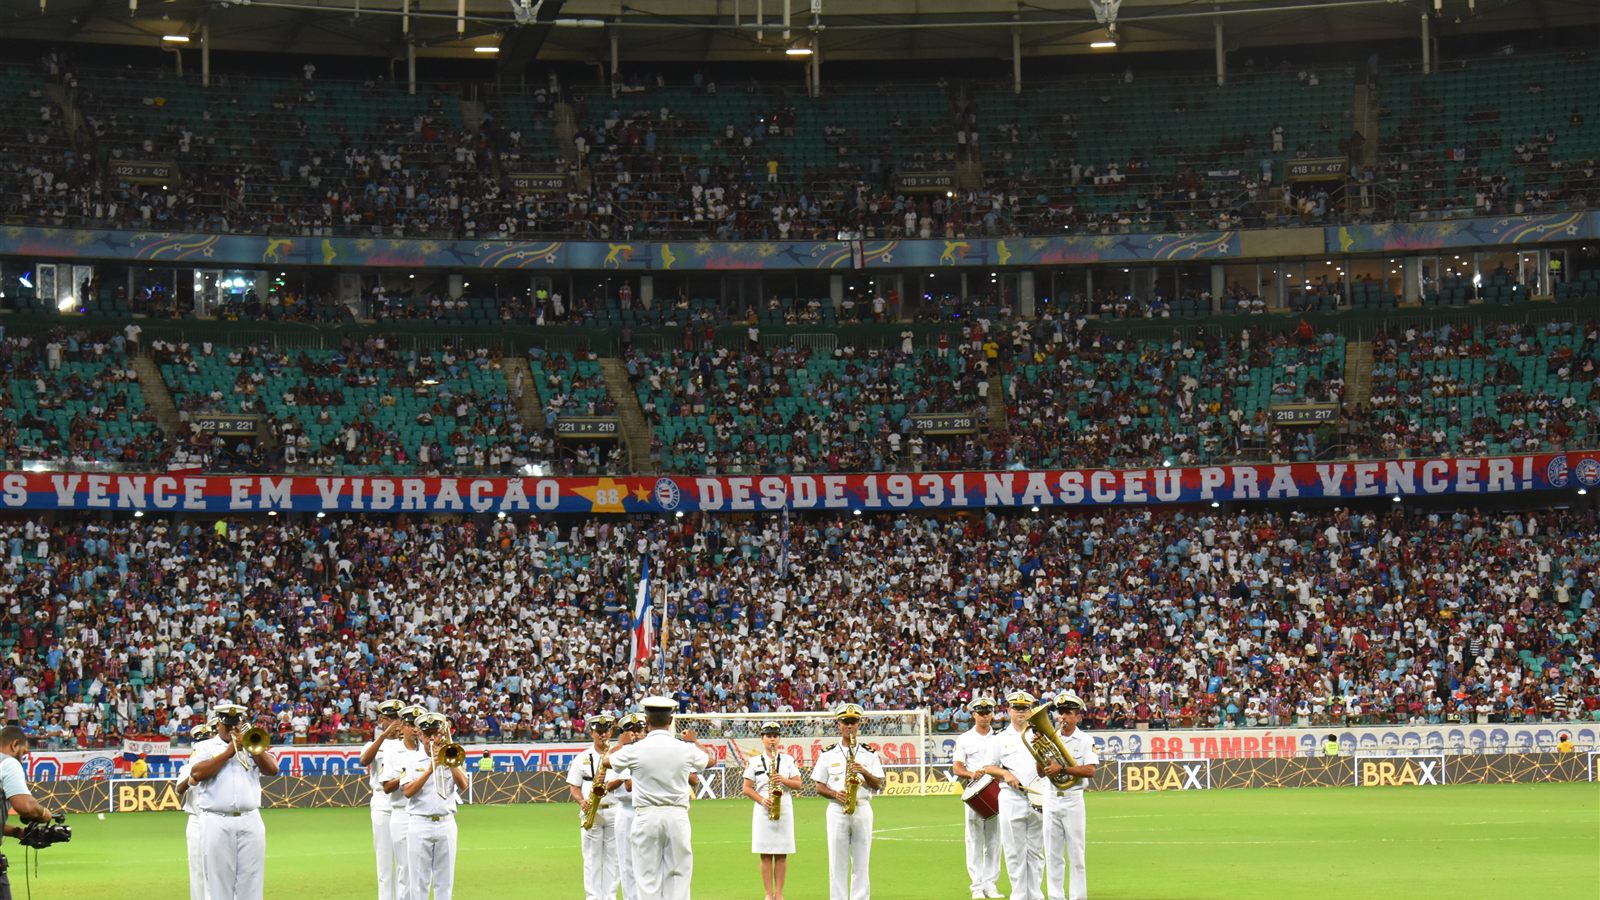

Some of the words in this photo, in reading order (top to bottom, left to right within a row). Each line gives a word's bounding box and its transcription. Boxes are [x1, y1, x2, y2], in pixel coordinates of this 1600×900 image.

[1292, 165, 1307, 174] 418
[1326, 164, 1342, 172] 417
[236, 421, 253, 430] 221
[917, 420, 933, 429] 219
[954, 419, 970, 428] 218
[1277, 411, 1294, 420] 218
[1315, 410, 1332, 419] 217
[558, 423, 574, 431] 221
[598, 423, 615, 432] 219
[51, 475, 207, 509] VENCE
[229, 477, 293, 510] EM
[316, 476, 561, 513] VIBRAÇÃO
[697, 477, 850, 511] DESDE
[865, 474, 969, 507] 1931
[985, 469, 1183, 505] NASCEU
[1200, 466, 1300, 500] PRA
[1316, 457, 1534, 497] VENCER!
[596, 488, 619, 506] 88
[1151, 737, 1184, 760] 88
[1190, 732, 1297, 759] TAMBÉM
[1127, 765, 1202, 791] BRAX
[1363, 761, 1437, 786] BRAX
[119, 785, 182, 812] BRA
